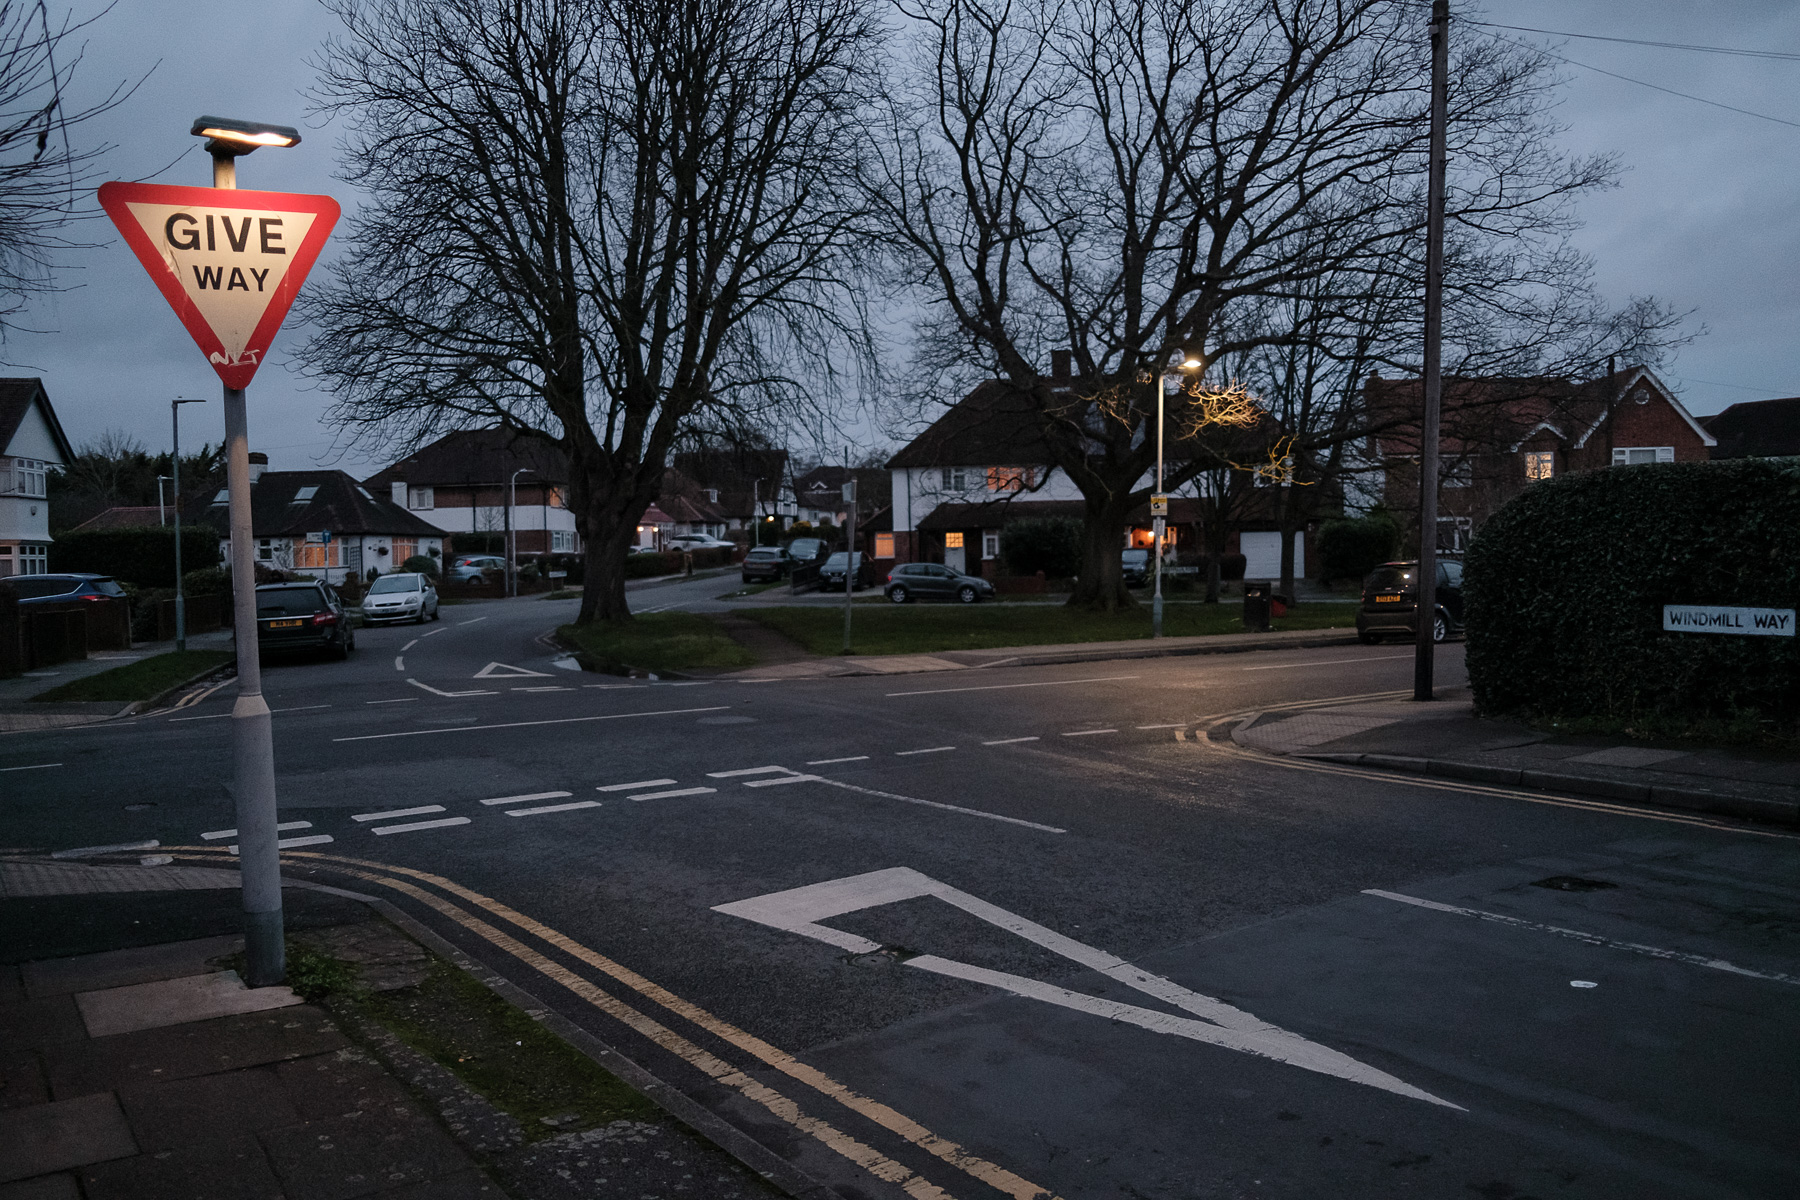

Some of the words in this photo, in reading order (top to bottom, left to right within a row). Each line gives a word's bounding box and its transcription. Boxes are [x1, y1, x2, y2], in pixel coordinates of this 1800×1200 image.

[166, 212, 286, 254] GIVE
[192, 265, 270, 292] WAY
[1669, 611, 1743, 628] WINDMILL
[1753, 614, 1789, 629] WAY
